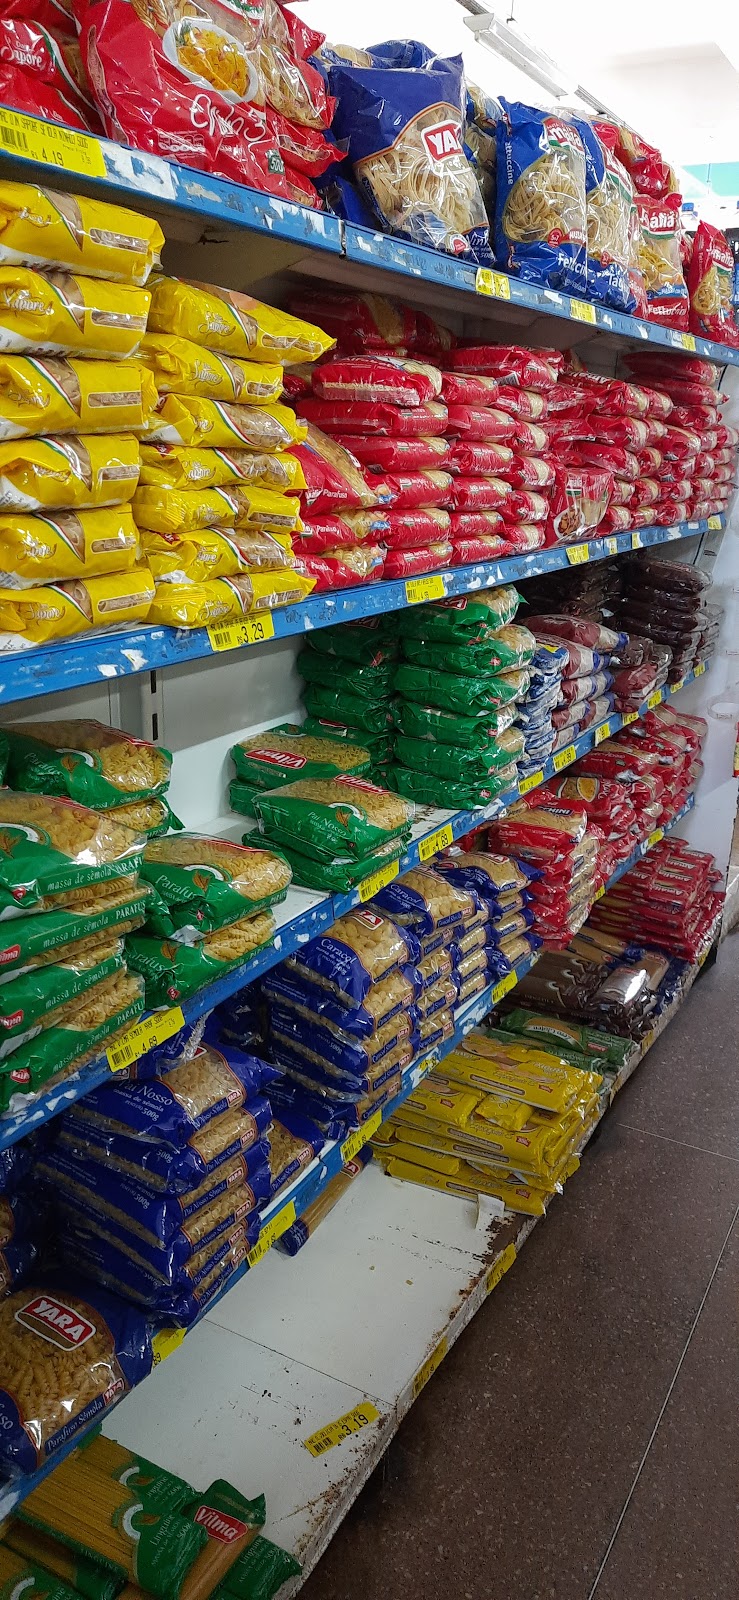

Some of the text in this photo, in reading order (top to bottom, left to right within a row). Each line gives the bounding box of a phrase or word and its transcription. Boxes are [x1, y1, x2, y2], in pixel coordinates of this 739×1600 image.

[1, 35, 43, 68] Sapore
[427, 130, 460, 156] YA
[41, 147, 65, 167] 4.19
[322, 488, 348, 499] Parafuso
[241, 622, 265, 643] 3.29
[321, 817, 348, 838] Nosso
[47, 878, 73, 892] massa
[74, 873, 85, 884] de
[87, 865, 112, 882] sêmola
[156, 874, 196, 900] Parafus
[43, 932, 69, 948] massa
[71, 926, 81, 938] de
[83, 917, 109, 934] sêmola
[0, 949, 19, 962] ilma
[320, 938, 357, 964] Caracol
[45, 965, 109, 1009] massa de sêmola
[52, 1053, 74, 1073] massa
[139, 1084, 174, 1107] Nosso
[141, 1106, 160, 1122] 500g
[156, 1149, 174, 1164] 500g
[32, 1299, 86, 1341] YARA
[46, 1400, 104, 1451] Parafuso Sêmola
[341, 1413, 369, 1436] 3.19
[196, 1507, 239, 1540] Vilma
